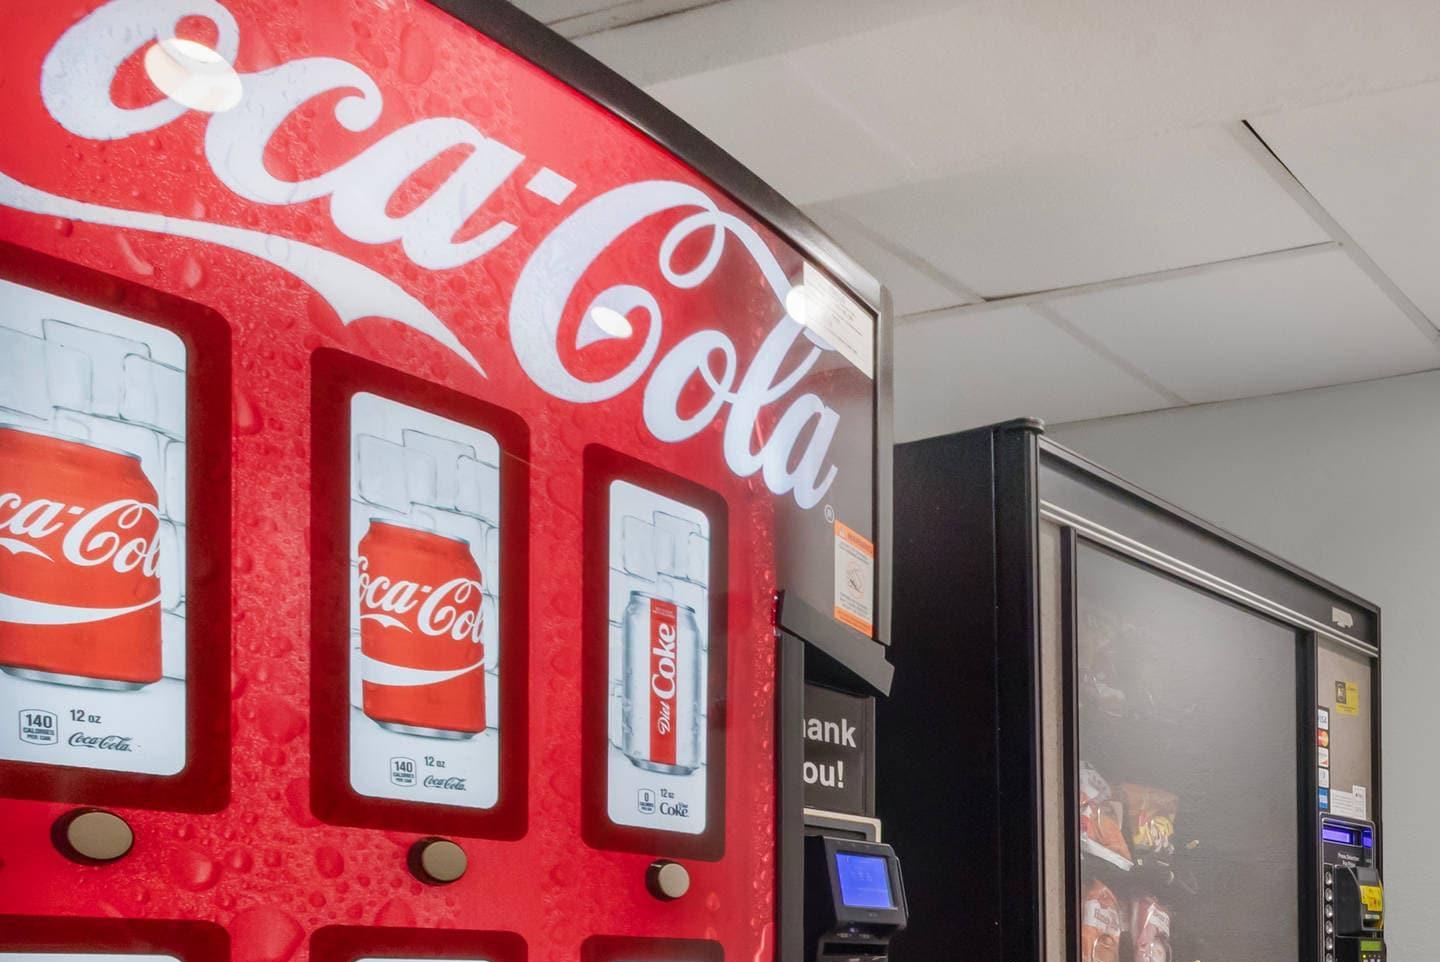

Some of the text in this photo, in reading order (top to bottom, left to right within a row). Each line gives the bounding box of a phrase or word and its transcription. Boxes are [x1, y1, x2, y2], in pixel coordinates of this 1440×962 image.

[651, 623, 676, 700] Coke
[26, 714, 52, 728] 140
[70, 709, 102, 724] 12 oz
[658, 701, 672, 736] Diet
[68, 732, 132, 752] Coca-Cola
[395, 761, 413, 773] 140
[424, 756, 434, 767] 12
[660, 788, 667, 798] 12
